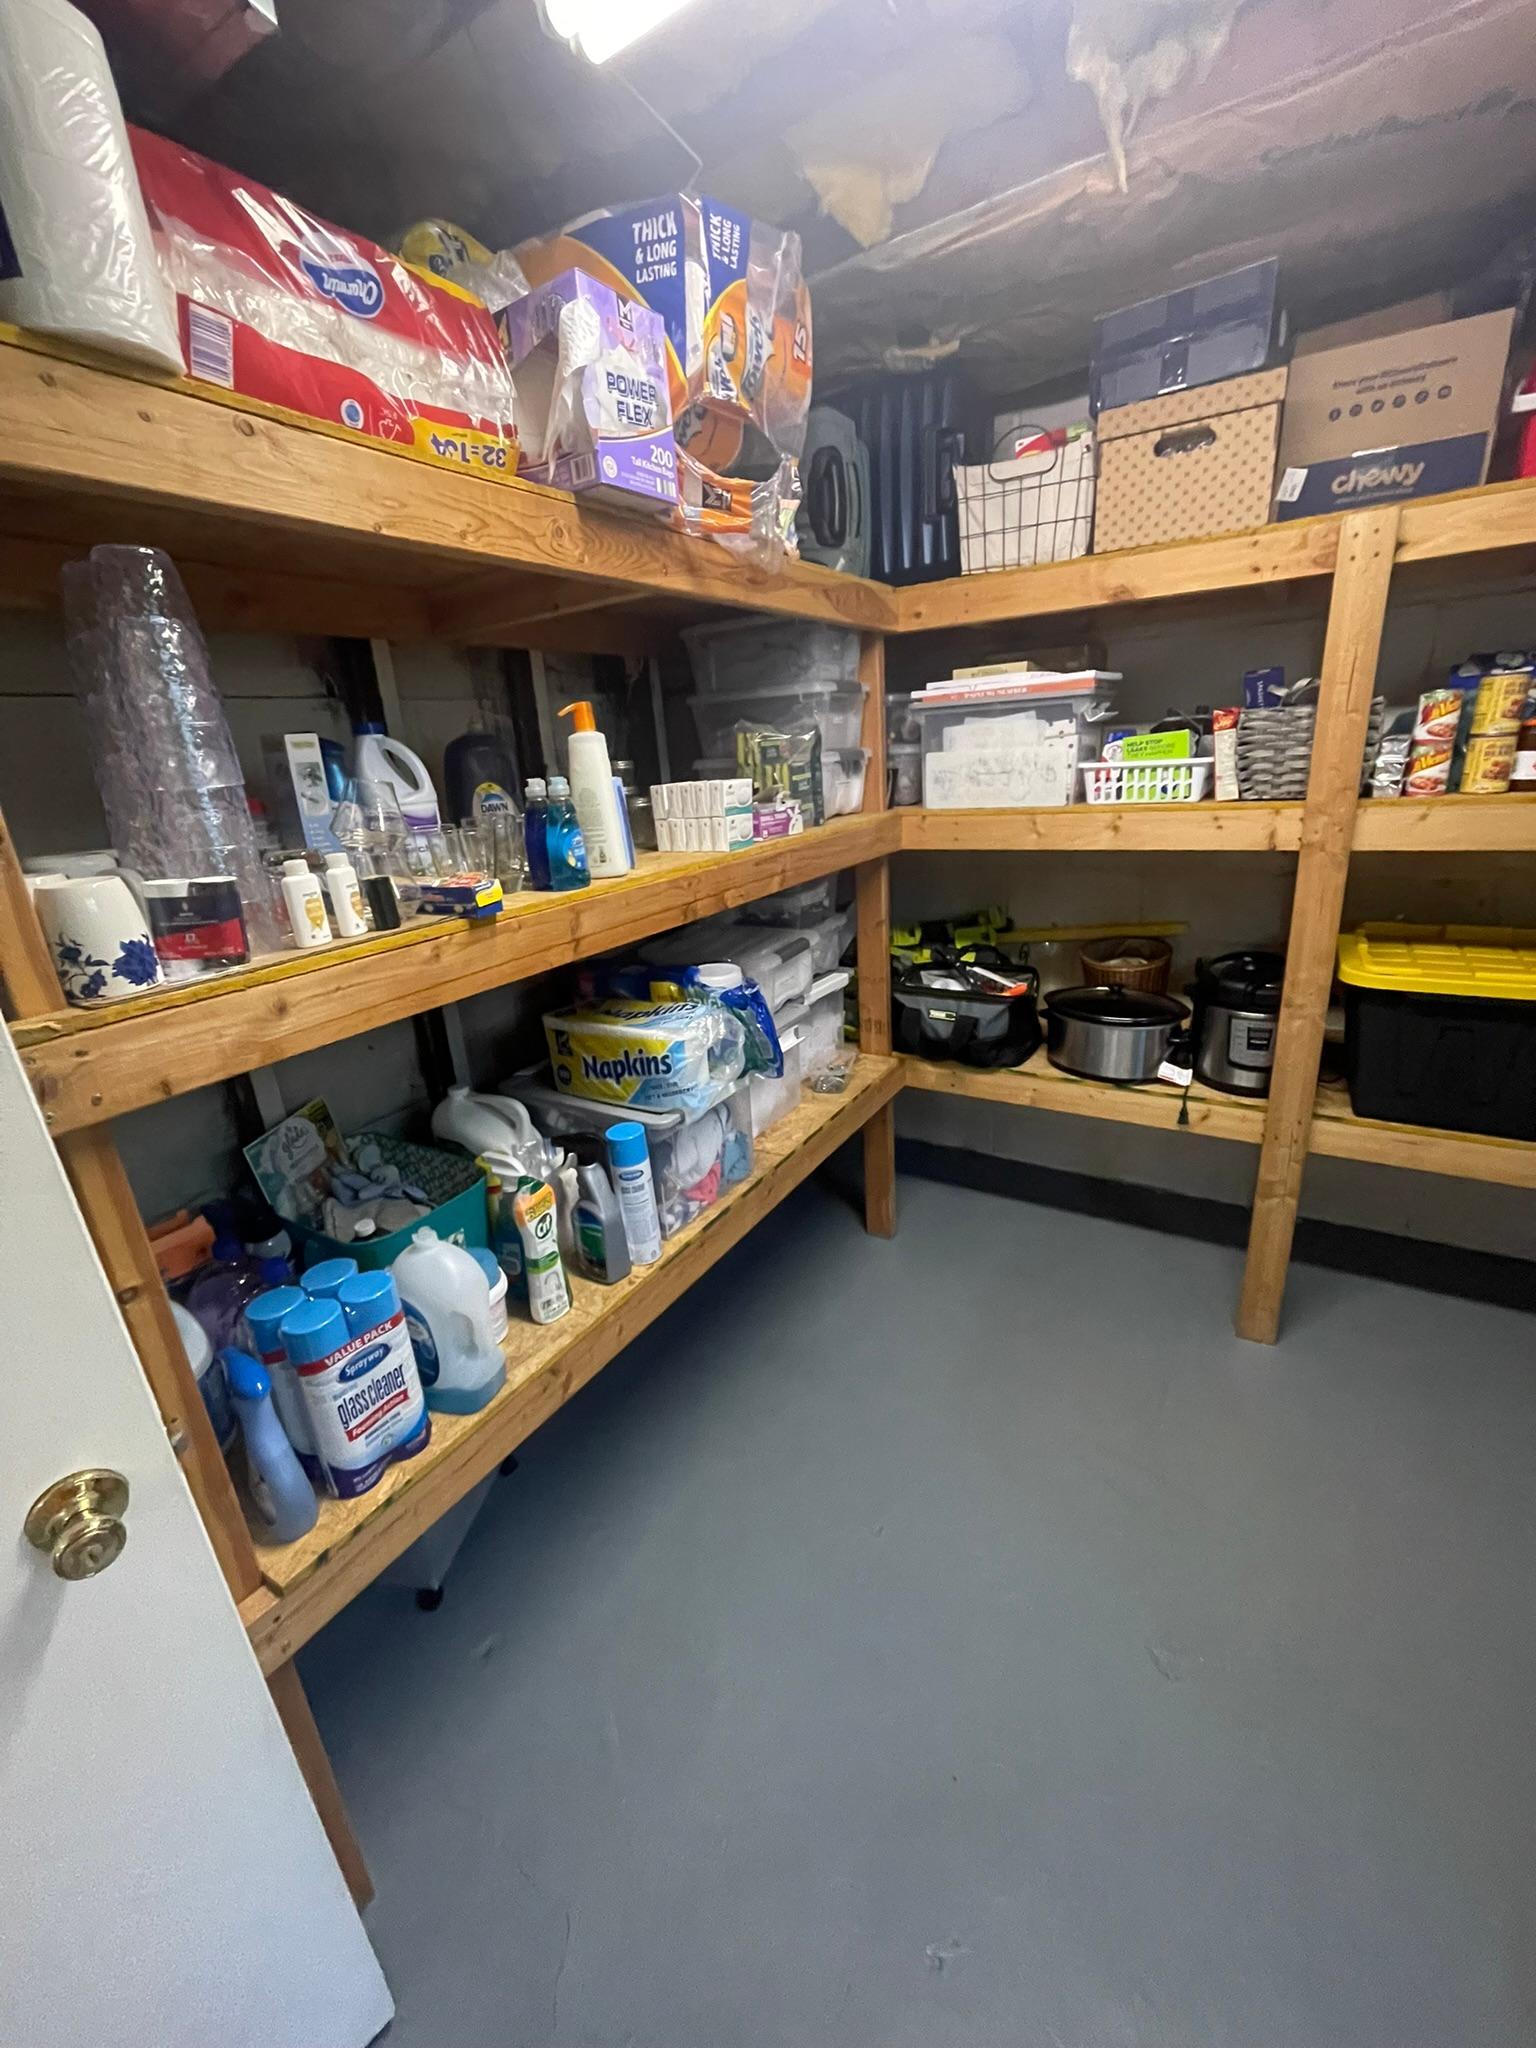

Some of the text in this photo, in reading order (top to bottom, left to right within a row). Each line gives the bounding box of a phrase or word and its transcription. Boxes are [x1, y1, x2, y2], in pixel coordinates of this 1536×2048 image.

[632, 211, 678, 245] THICK
[709, 213, 723, 260] THICK
[721, 219, 732, 254] LONG
[635, 240, 677, 265] & LONG
[730, 224, 741, 270] LASTING
[322, 272, 379, 306] Charmin
[636, 261, 677, 284] LASTING
[606, 371, 658, 407] POWER
[617, 400, 656, 429] FLEX
[650, 444, 673, 469] 200
[1331, 461, 1426, 495] chewy
[481, 801, 509, 814] DAWN
[582, 1048, 672, 1085] Napkins
[325, 1321, 393, 1366] VALUE PACK
[345, 1346, 385, 1377] Sprayway
[337, 1387, 370, 1430] glass
[367, 1363, 406, 1407] cleaner
